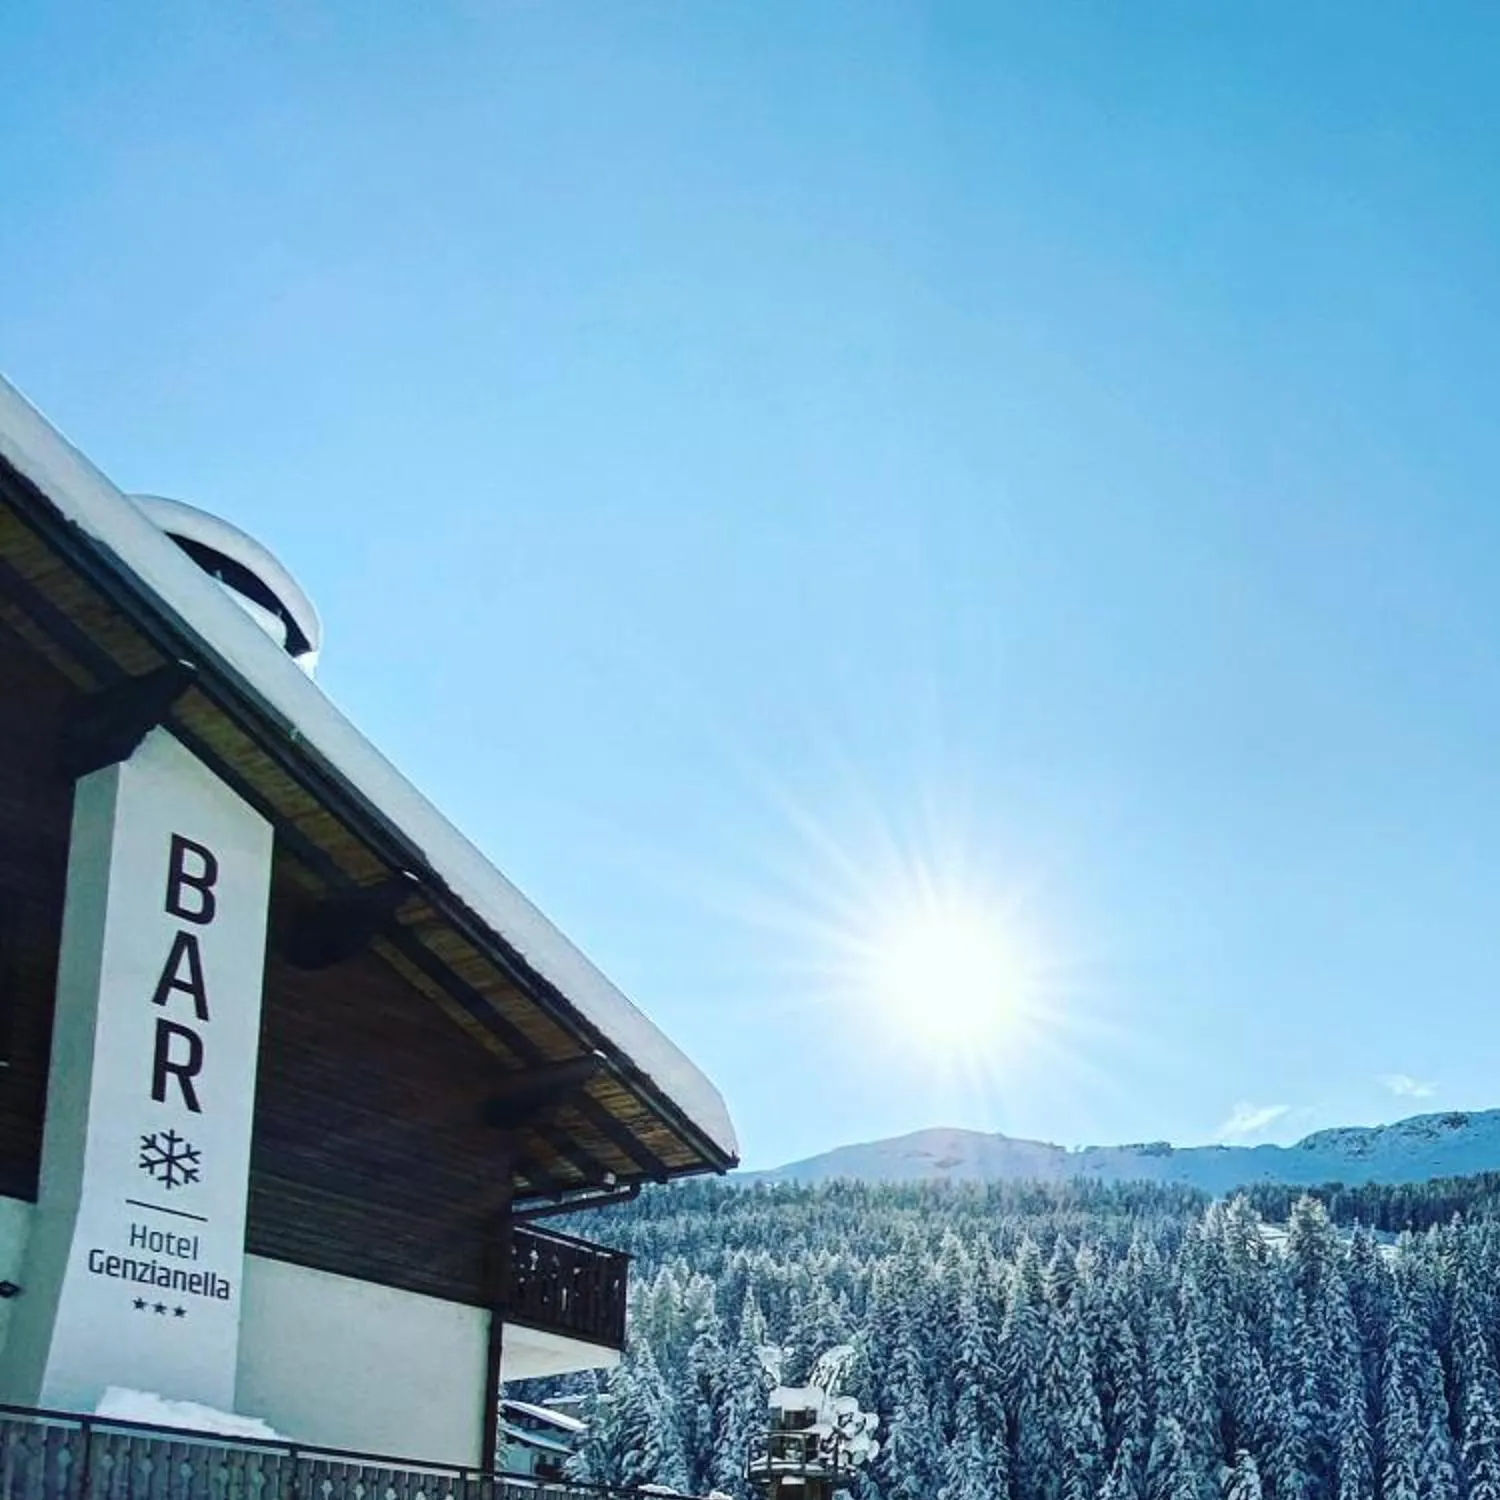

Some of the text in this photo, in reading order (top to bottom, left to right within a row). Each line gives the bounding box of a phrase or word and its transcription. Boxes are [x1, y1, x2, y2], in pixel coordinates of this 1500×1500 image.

[151, 832, 218, 1114] BAR
[129, 1222, 199, 1261] Hotel
[88, 1249, 229, 1300] Genzianella
